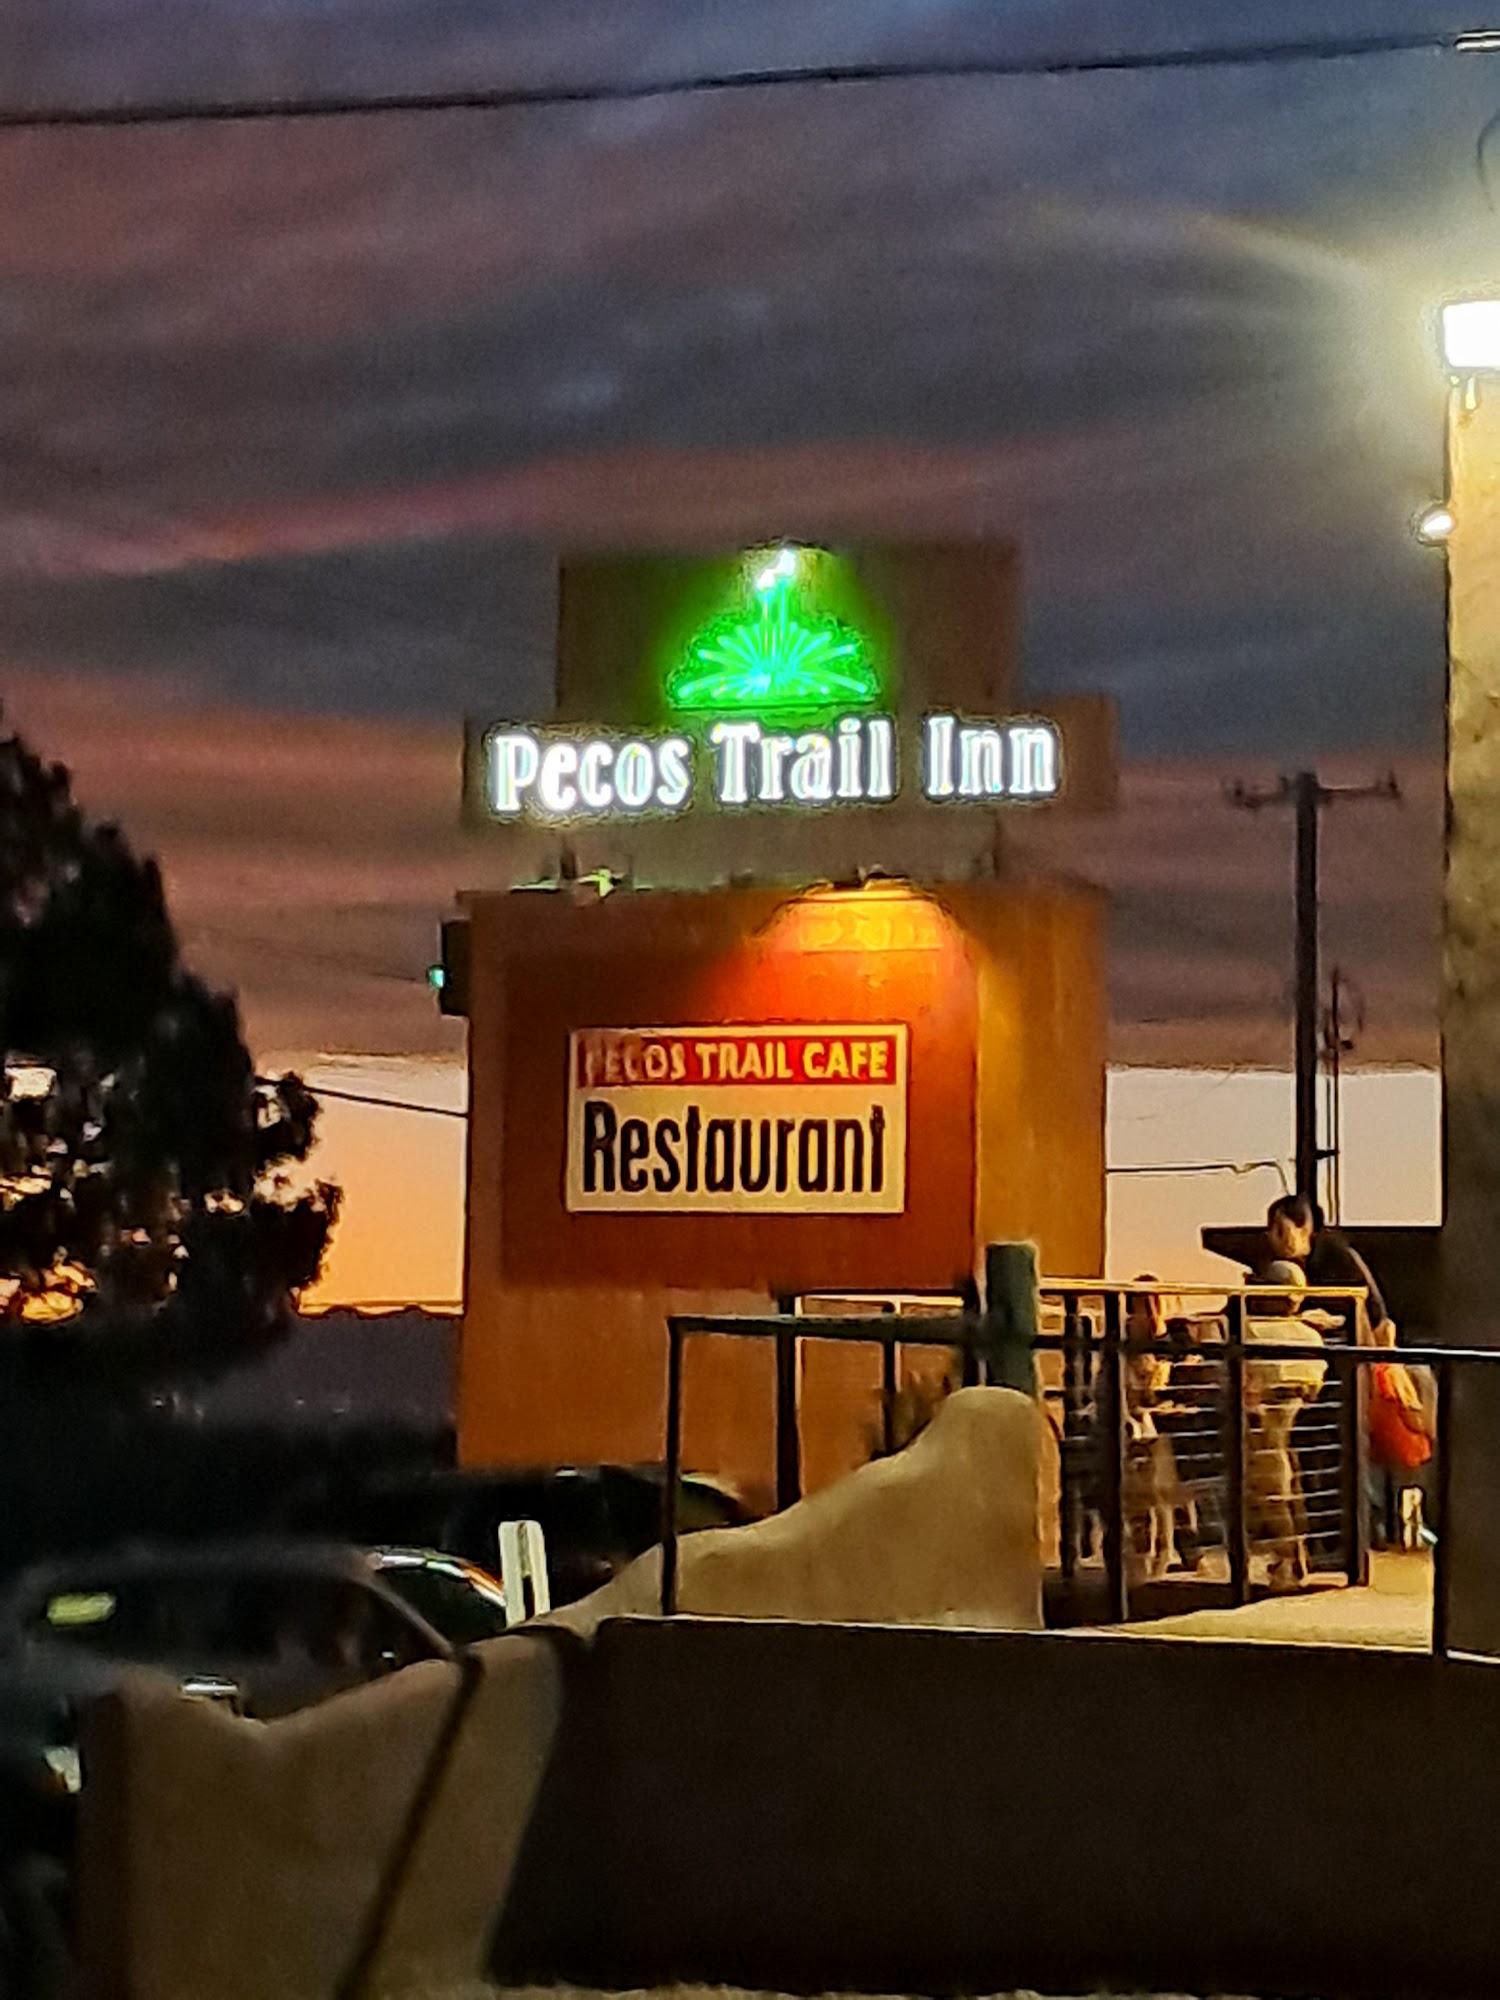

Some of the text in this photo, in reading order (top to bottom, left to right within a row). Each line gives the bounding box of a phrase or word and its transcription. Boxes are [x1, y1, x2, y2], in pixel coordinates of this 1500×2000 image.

[494, 716, 1057, 811] Pecos Trail Inn
[695, 1042, 793, 1079] TRAIL
[803, 1042, 889, 1079] CAFE
[583, 1101, 885, 1193] Restaurant
